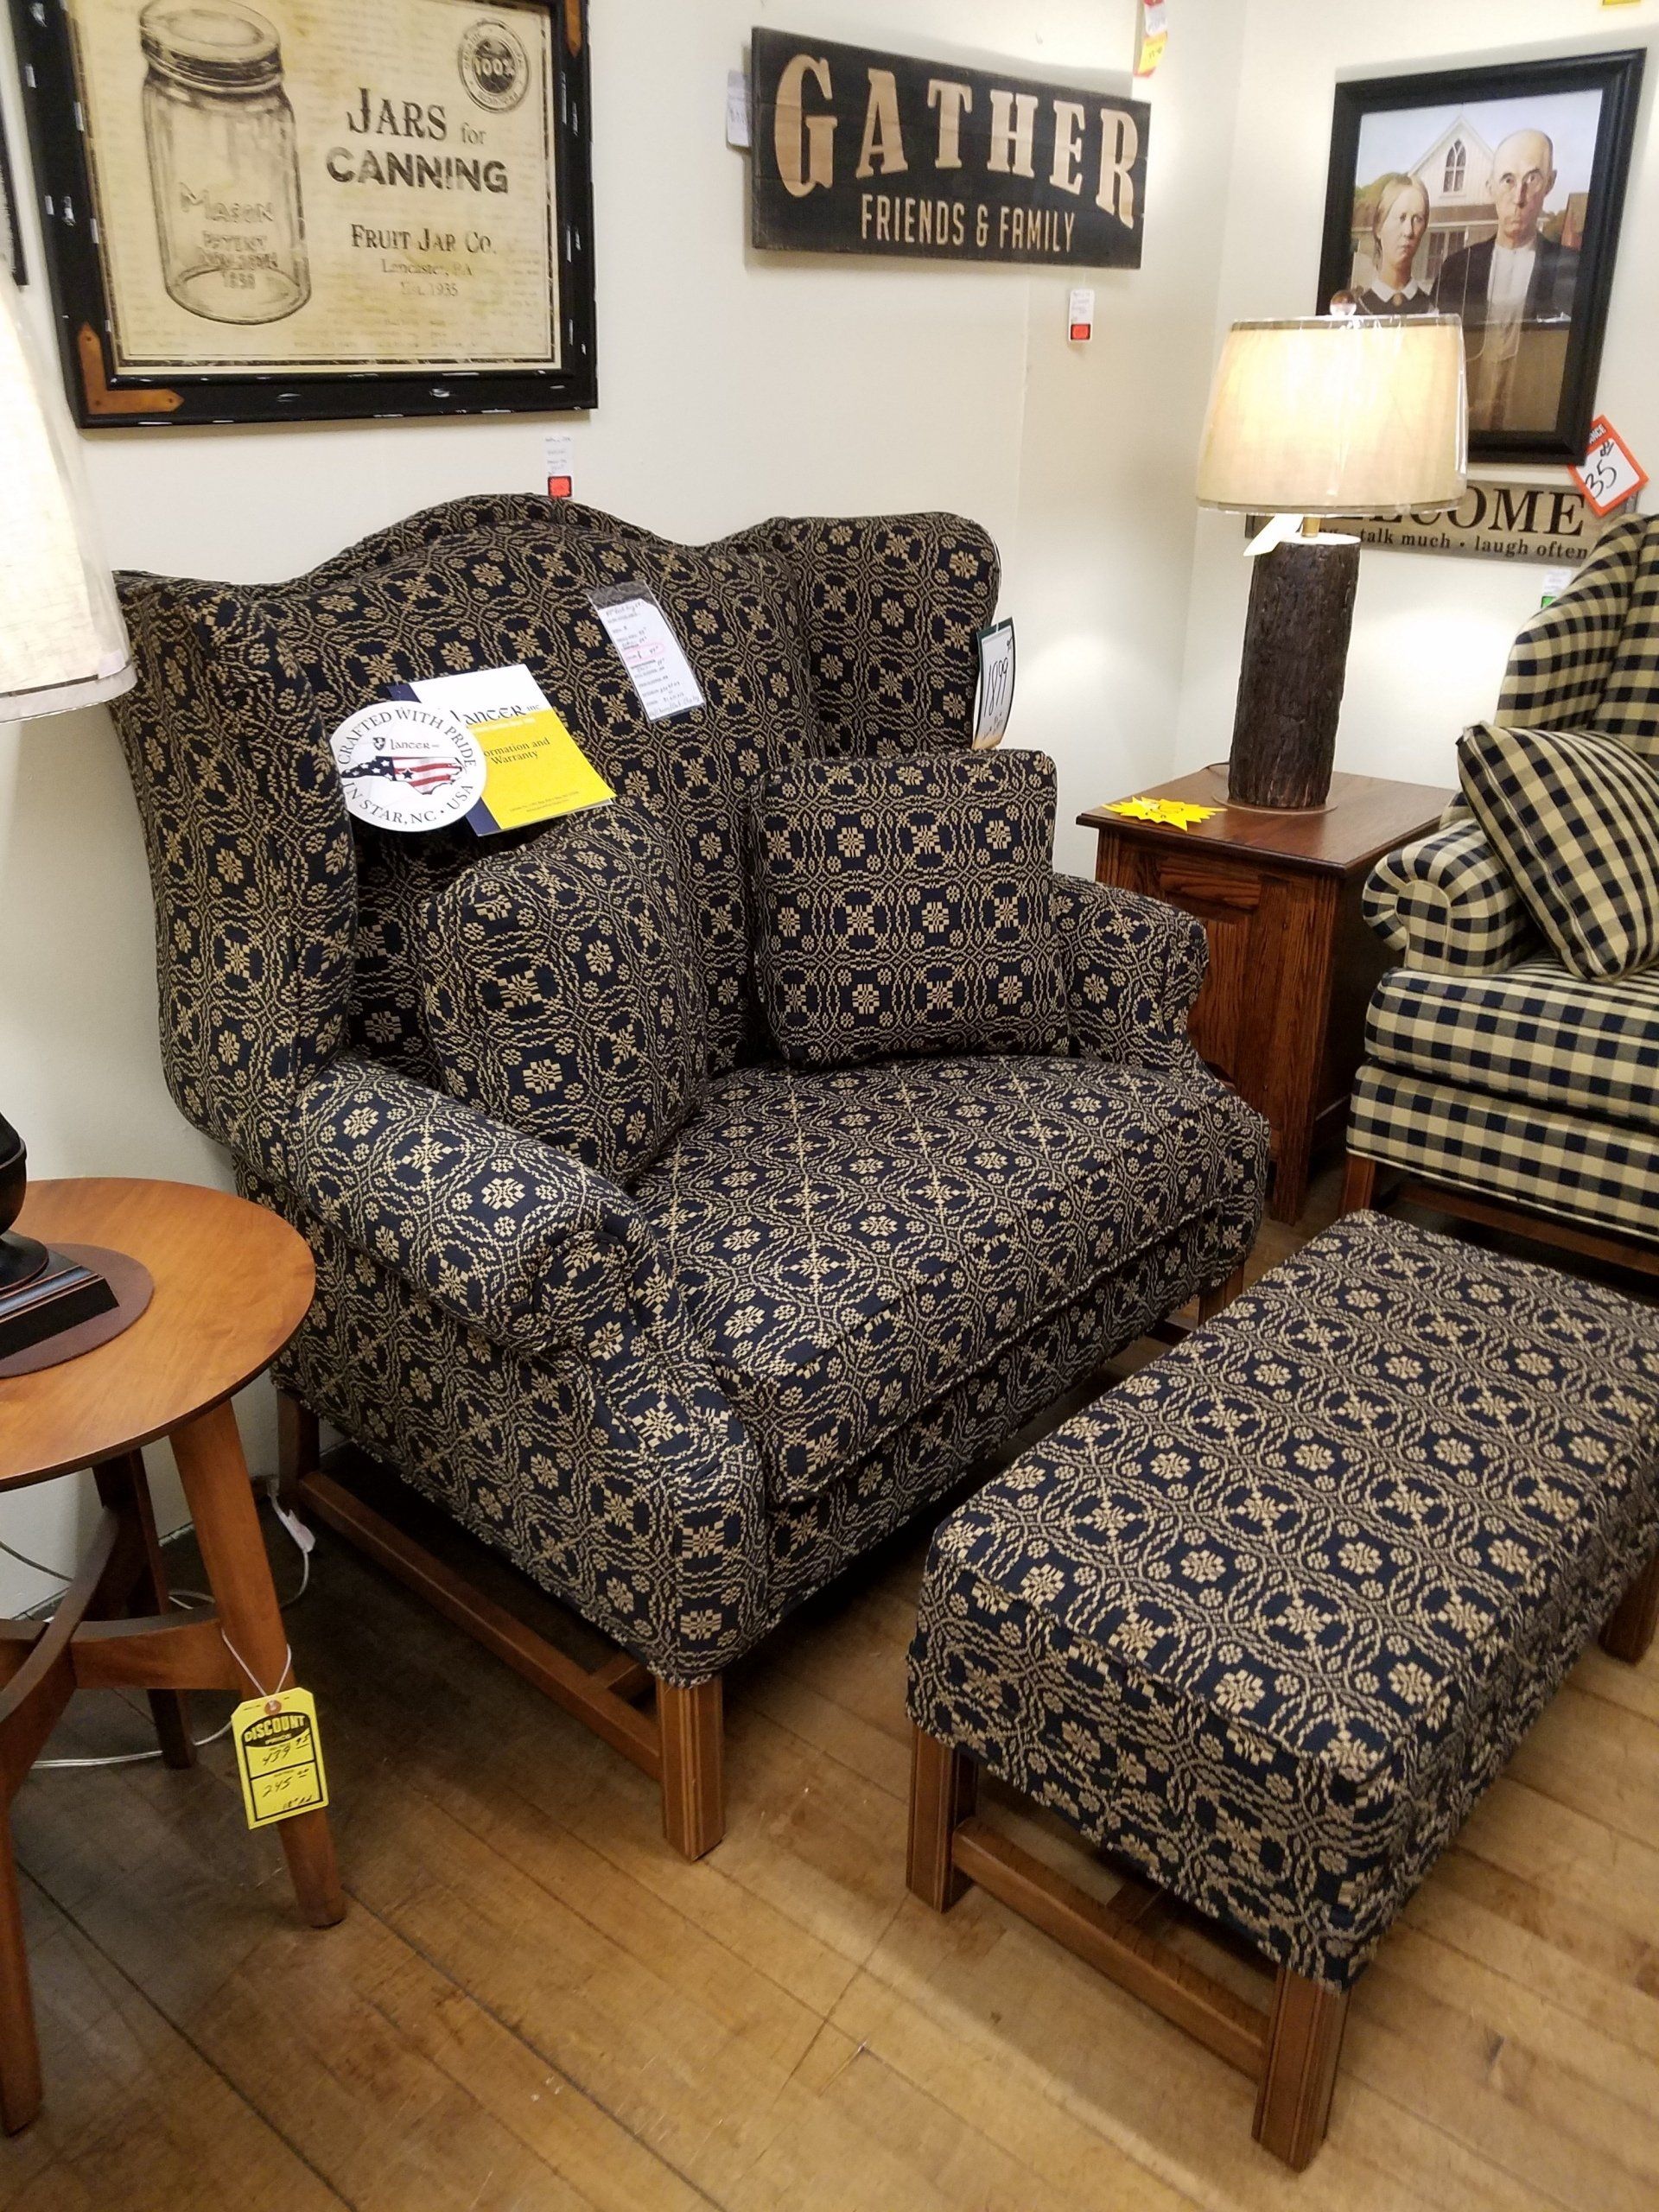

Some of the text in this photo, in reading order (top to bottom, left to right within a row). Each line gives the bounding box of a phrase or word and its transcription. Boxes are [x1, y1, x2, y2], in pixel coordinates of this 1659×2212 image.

[461, 122, 486, 144] for
[774, 53, 1140, 229] GATHER
[326, 146, 509, 194] CANNING
[861, 193, 1076, 252] FRIENDS & FAMILY
[1585, 459, 1617, 499] 35
[1360, 528, 1588, 560] talk much laugh often
[338, 709, 477, 767] CRAFTED WITH PRIDE
[483, 737, 550, 758] ormation and
[491, 750, 539, 766] Warranty
[342, 781, 474, 825] IN STAR, NC USA
[244, 1715, 306, 1743] DISCOUNT
